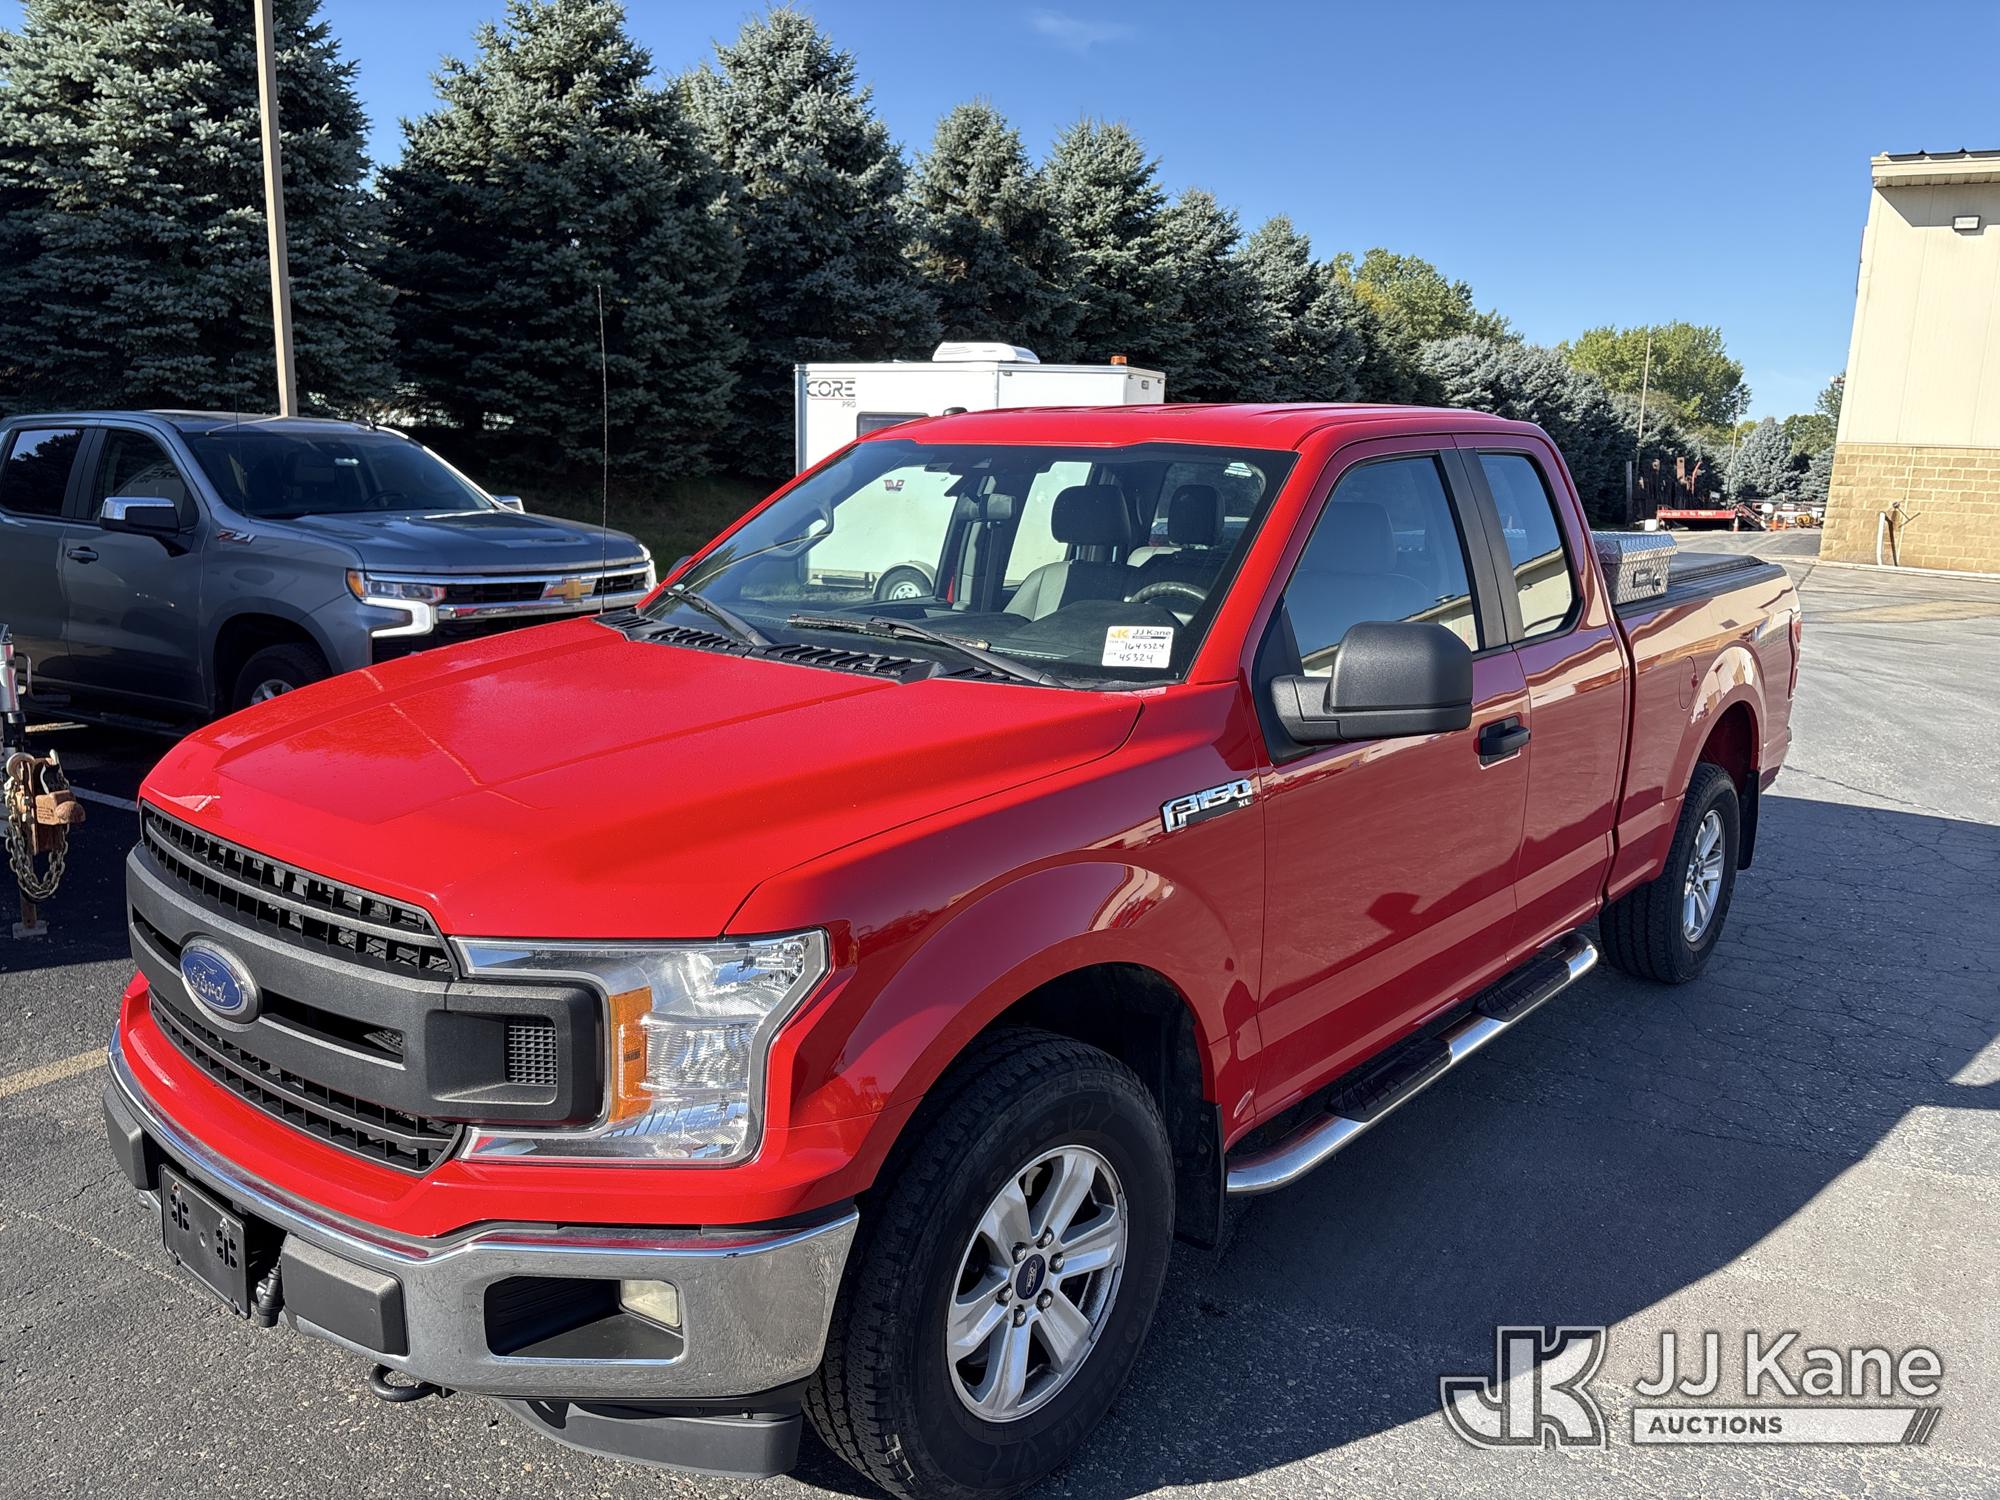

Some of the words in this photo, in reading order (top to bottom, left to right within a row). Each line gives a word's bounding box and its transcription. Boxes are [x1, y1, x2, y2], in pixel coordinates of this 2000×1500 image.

[807, 381, 856, 397] CORE
[1120, 653, 1154, 664] 45324
[1239, 798, 1251, 808] XL
[189, 959, 227, 1002] Ford
